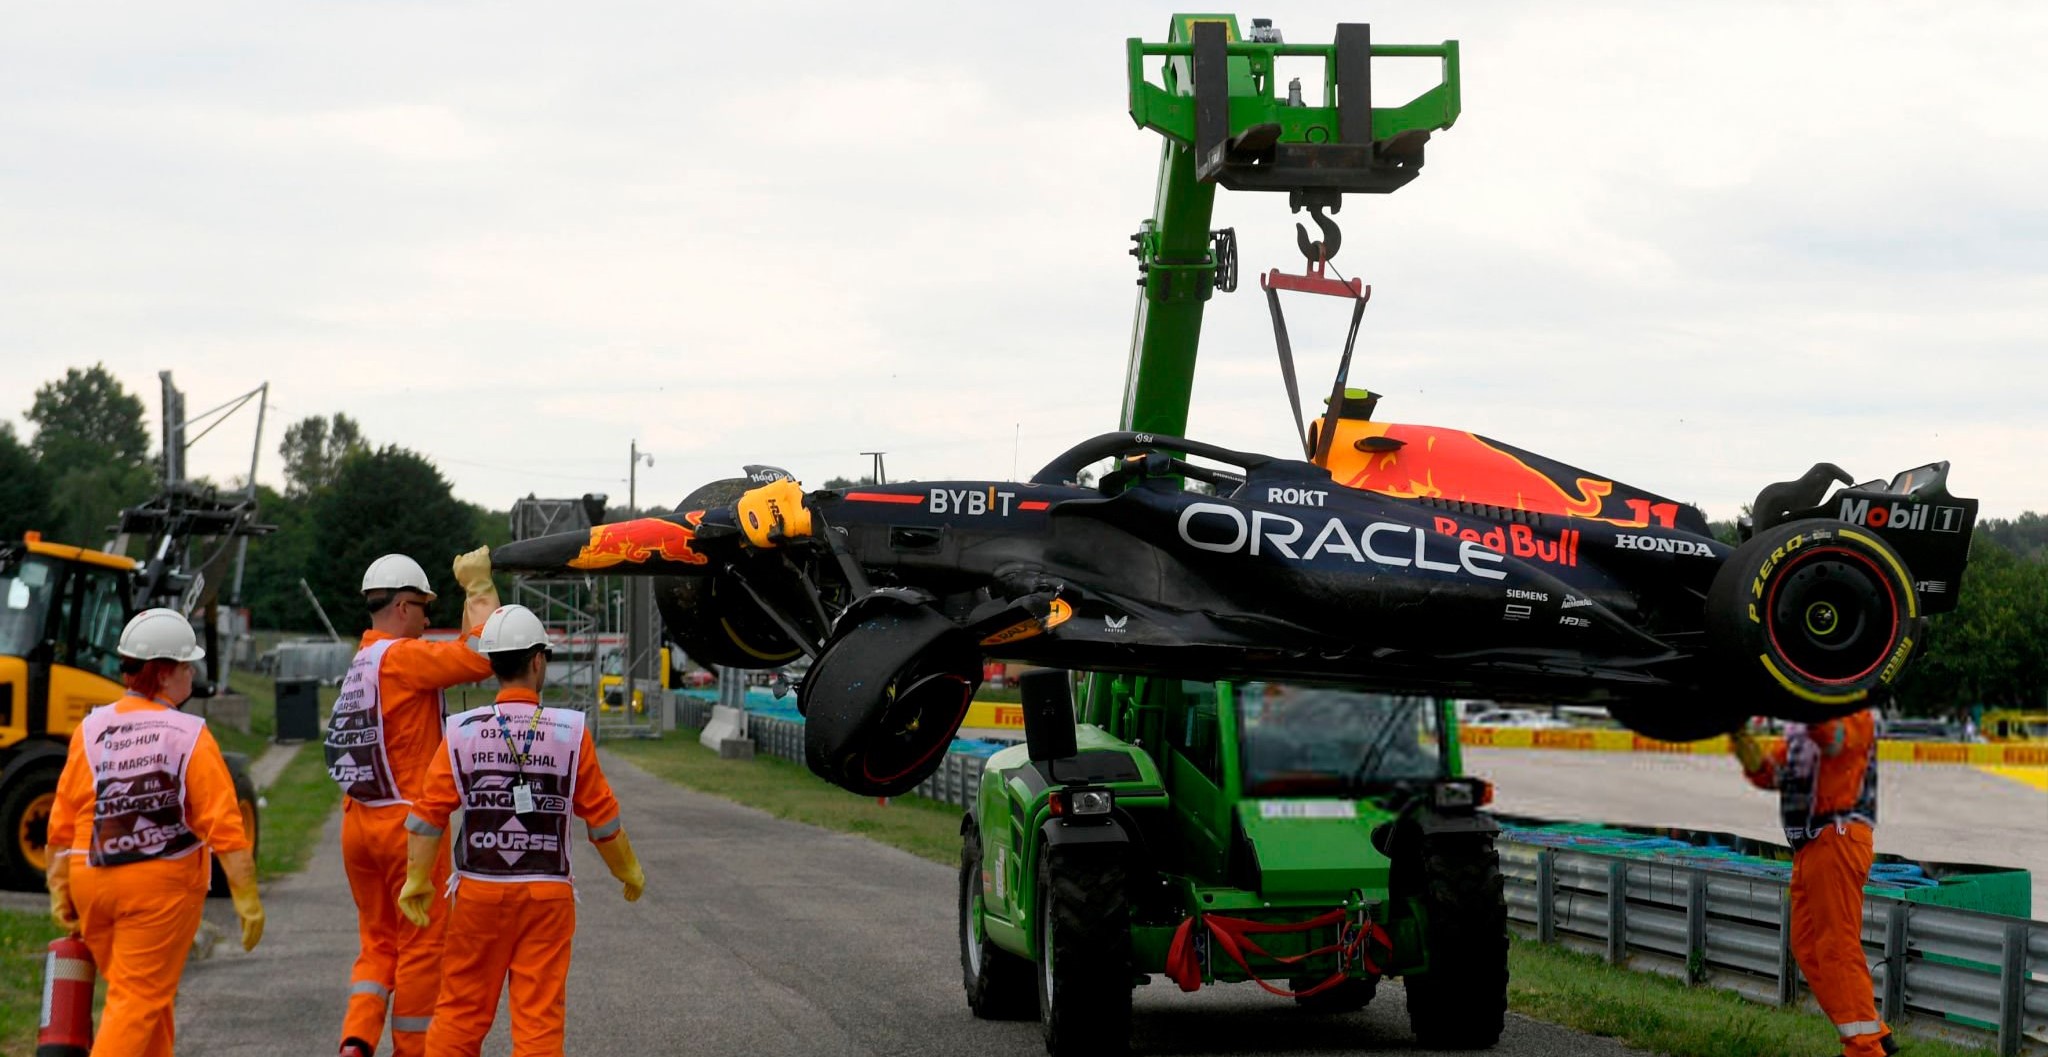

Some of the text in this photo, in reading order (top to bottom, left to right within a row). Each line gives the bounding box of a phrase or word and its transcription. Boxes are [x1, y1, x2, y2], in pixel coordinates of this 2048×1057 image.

[930, 485, 1016, 517] BYBIT
[1267, 487, 1330, 507] ROKT
[1625, 498, 1680, 529] 11
[1839, 498, 1954, 531] Mobil 1
[1178, 502, 1508, 581] ORACLE
[1434, 516, 1580, 567] Red Bull
[1615, 533, 1717, 559] HONDA
[1751, 533, 1803, 600] ZERO
[1506, 588, 1549, 602] SIEMENS
[480, 728, 545, 742] 037-HN
[497, 753, 557, 768] MASHAL
[469, 831, 558, 852] COURSE
